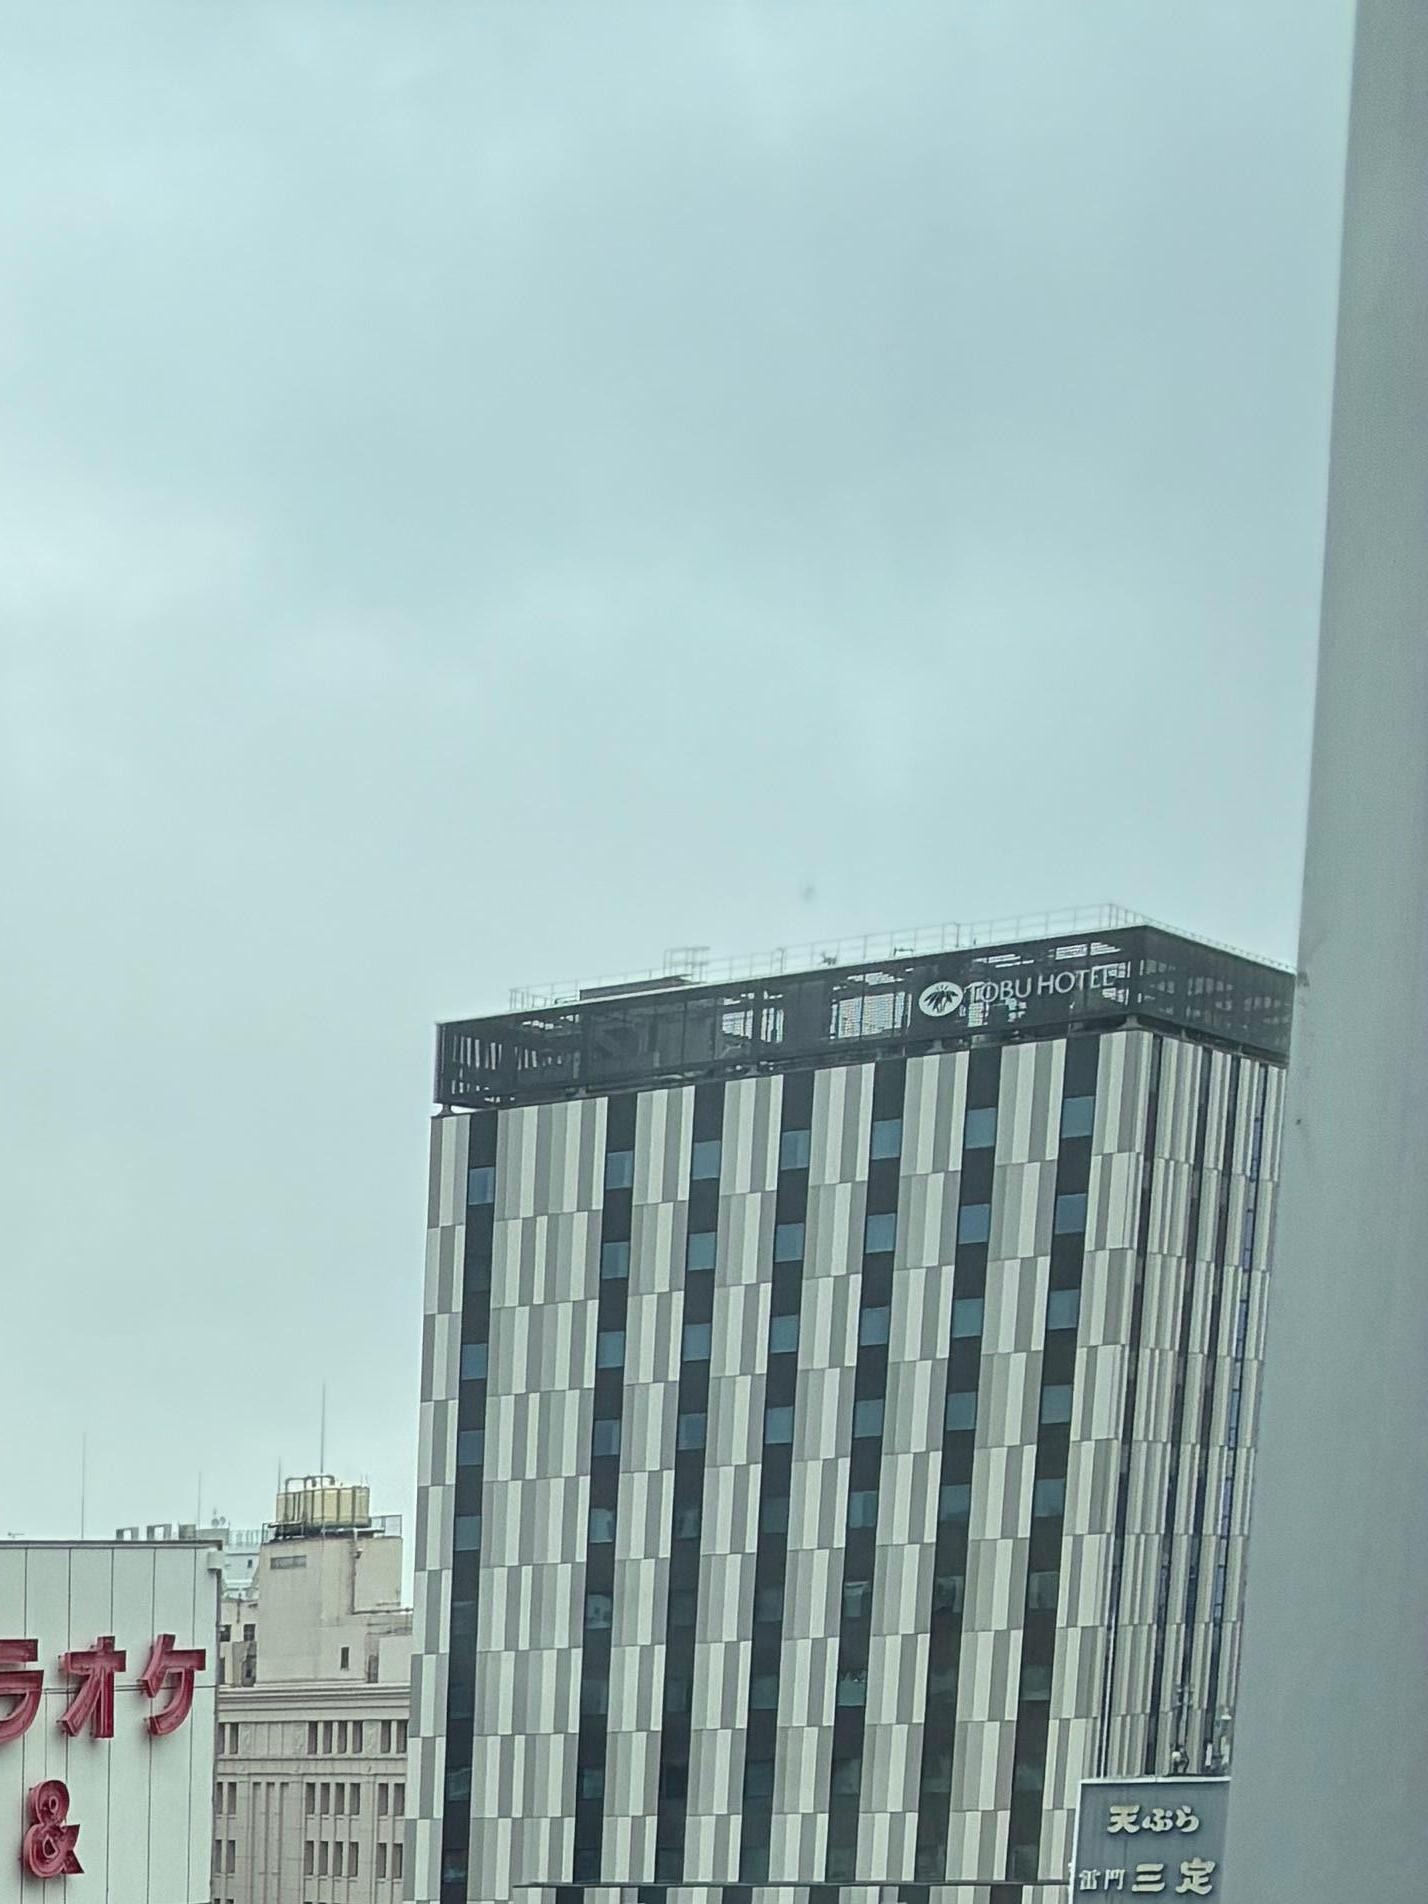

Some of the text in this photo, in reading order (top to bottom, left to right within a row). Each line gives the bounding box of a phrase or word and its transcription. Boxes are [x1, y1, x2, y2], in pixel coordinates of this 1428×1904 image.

[965, 967, 1117, 1004] TOBU HOTEL
[22, 1778, 84, 1880] &
[1106, 1804, 1201, 1834] 天ぷら
[1078, 1856, 1216, 1896] 雷門 三定
